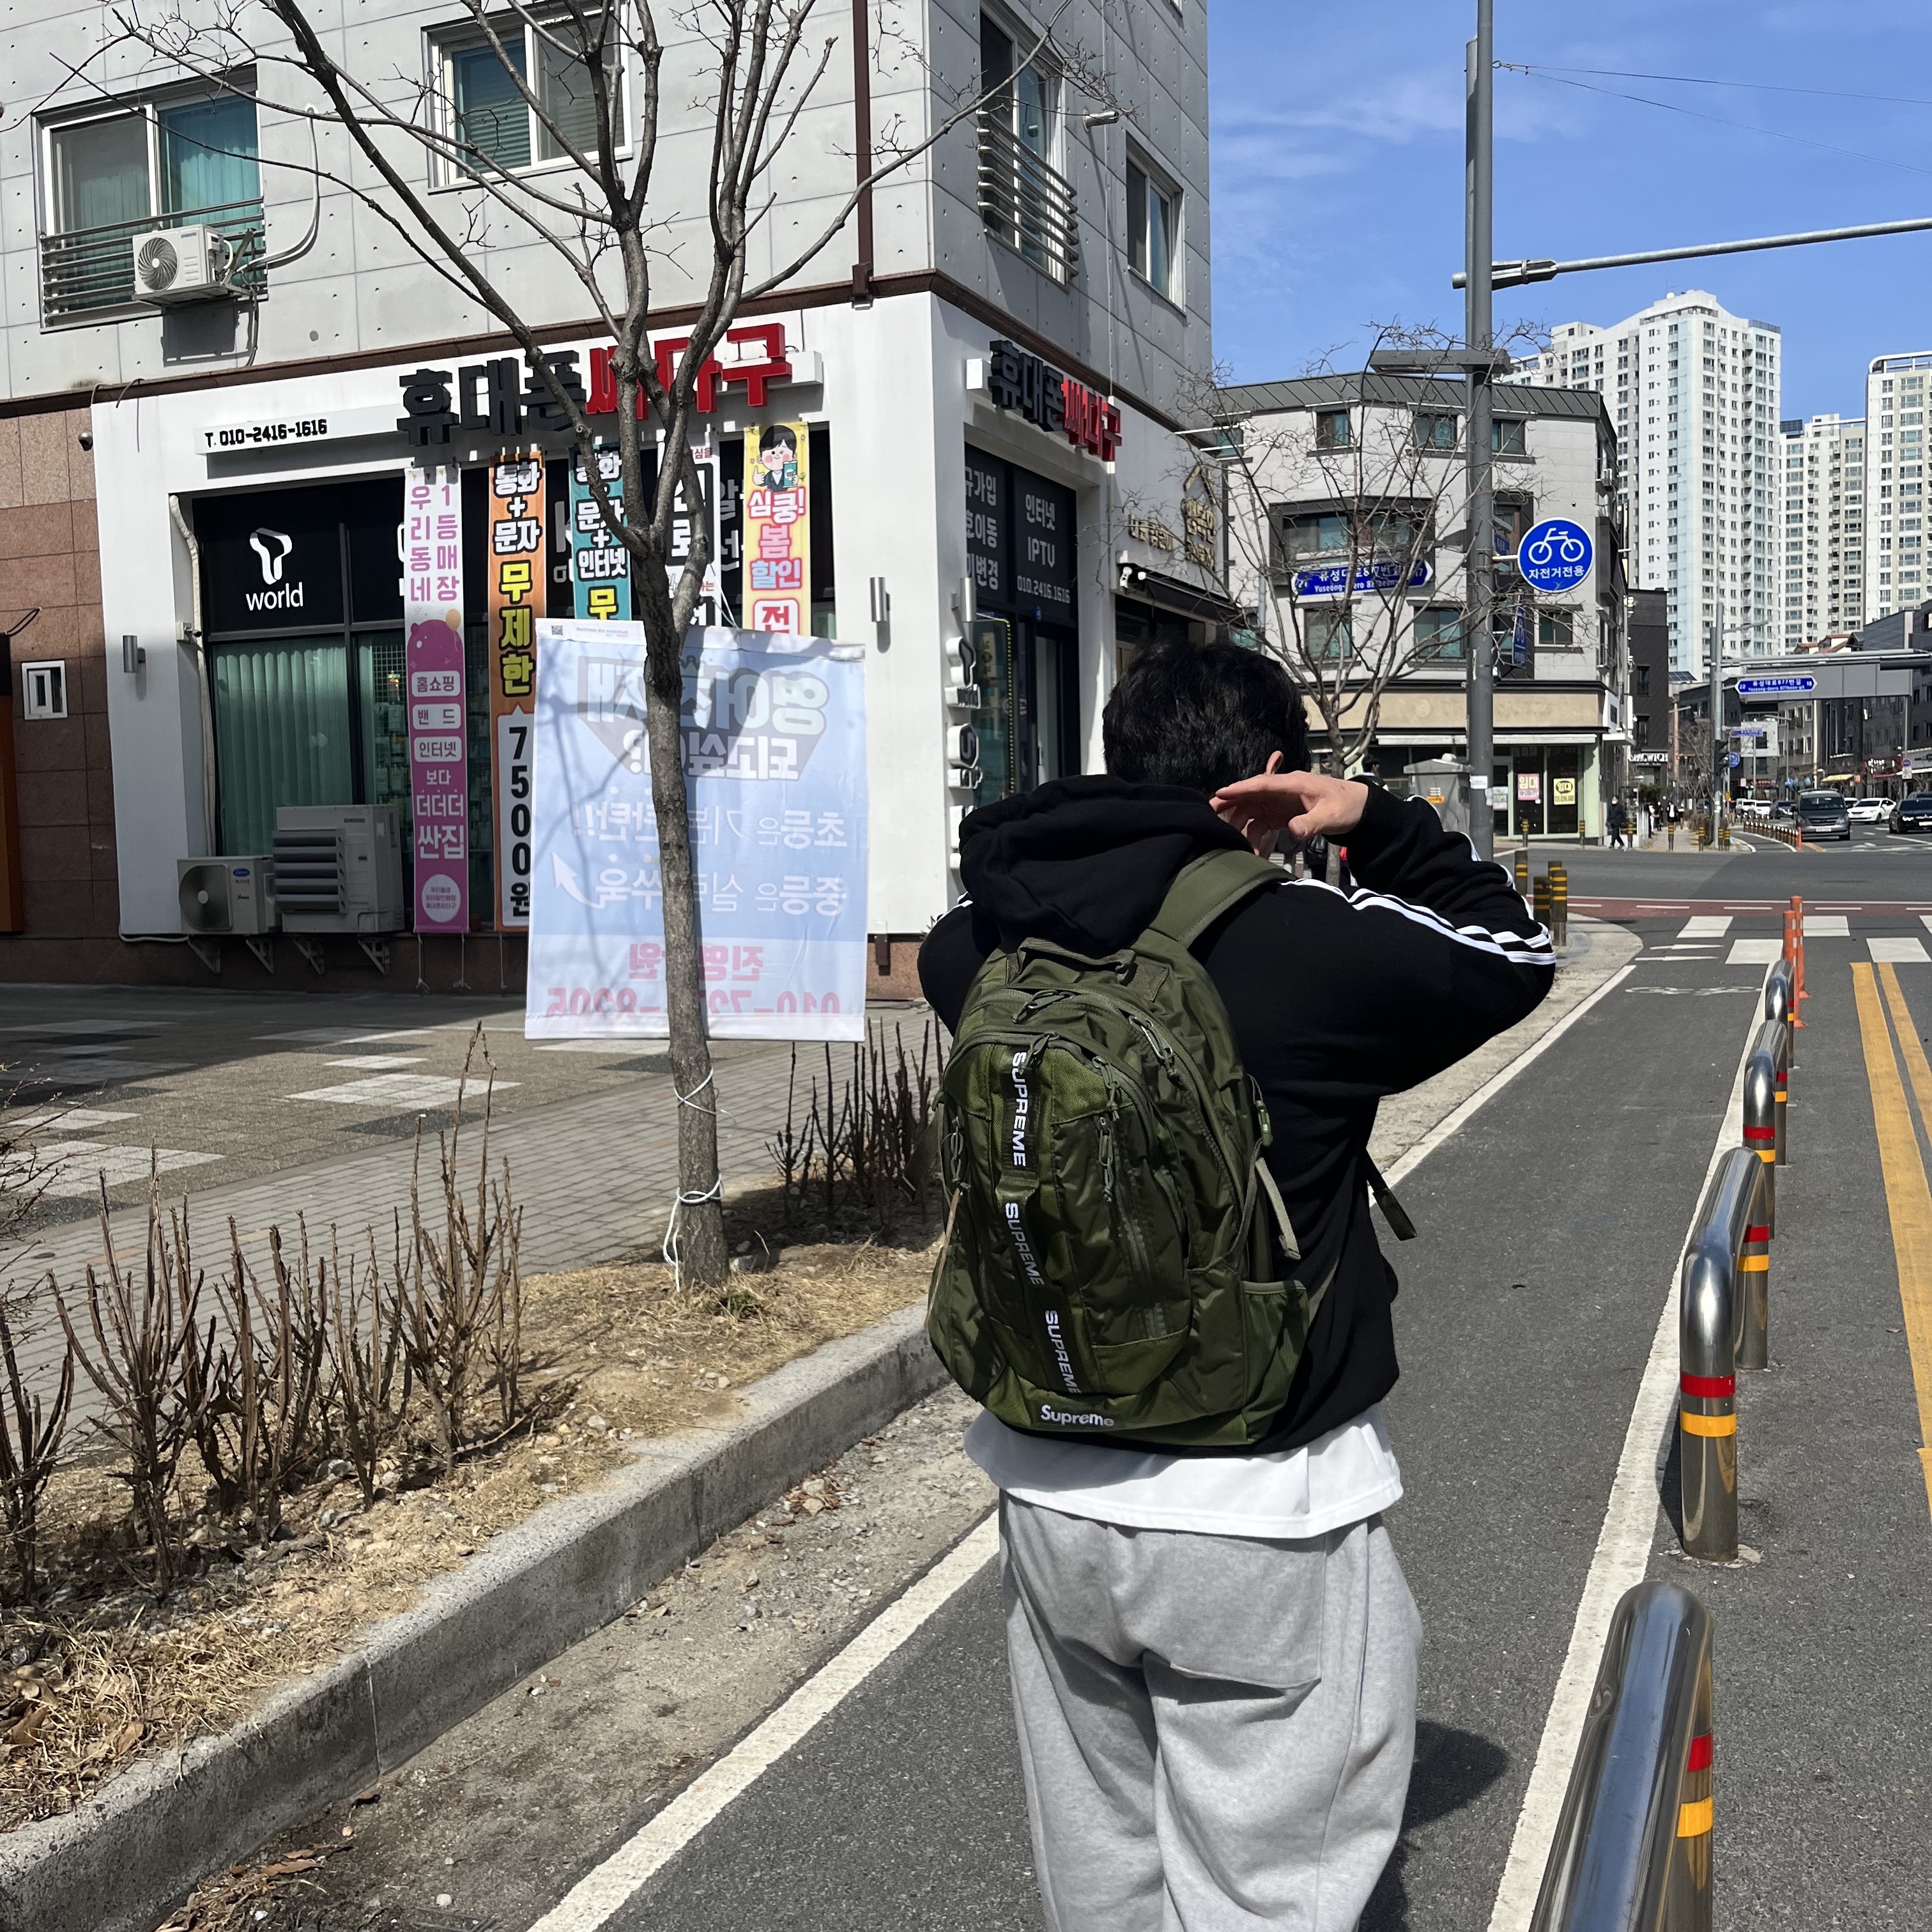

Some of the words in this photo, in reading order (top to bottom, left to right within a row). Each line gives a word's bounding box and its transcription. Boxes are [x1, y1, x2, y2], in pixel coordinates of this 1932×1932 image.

[218, 419, 328, 446] 010-2416-1616
[495, 461, 540, 495] 통화
[749, 488, 805, 524] 심쿵!
[1025, 494, 1055, 531] 인터넷
[410, 486, 431, 601] 우리동네
[494, 519, 540, 553] 문자
[760, 525, 791, 559] 봄
[578, 548, 626, 579] 인터넷
[1028, 537, 1055, 568] IPTV
[752, 560, 801, 589] 할인
[1314, 581, 1364, 593] Yuseong-ero
[1528, 565, 1585, 580] 자전거전용
[246, 581, 303, 611] world
[1017, 575, 1071, 604] 010.2416.1616
[501, 563, 533, 694] 무제한
[417, 675, 455, 693] 홈쇼핑
[419, 741, 456, 758] 인터넷
[426, 769, 451, 785] 보다
[1519, 776, 1538, 790] 임대
[418, 825, 464, 860] 싼집
[1012, 1052, 1029, 1167] SUPREME
[1006, 1202, 1045, 1285] SUPREME
[1045, 1310, 1082, 1394] SUPREME
[1041, 1404, 1115, 1427] Supreme
